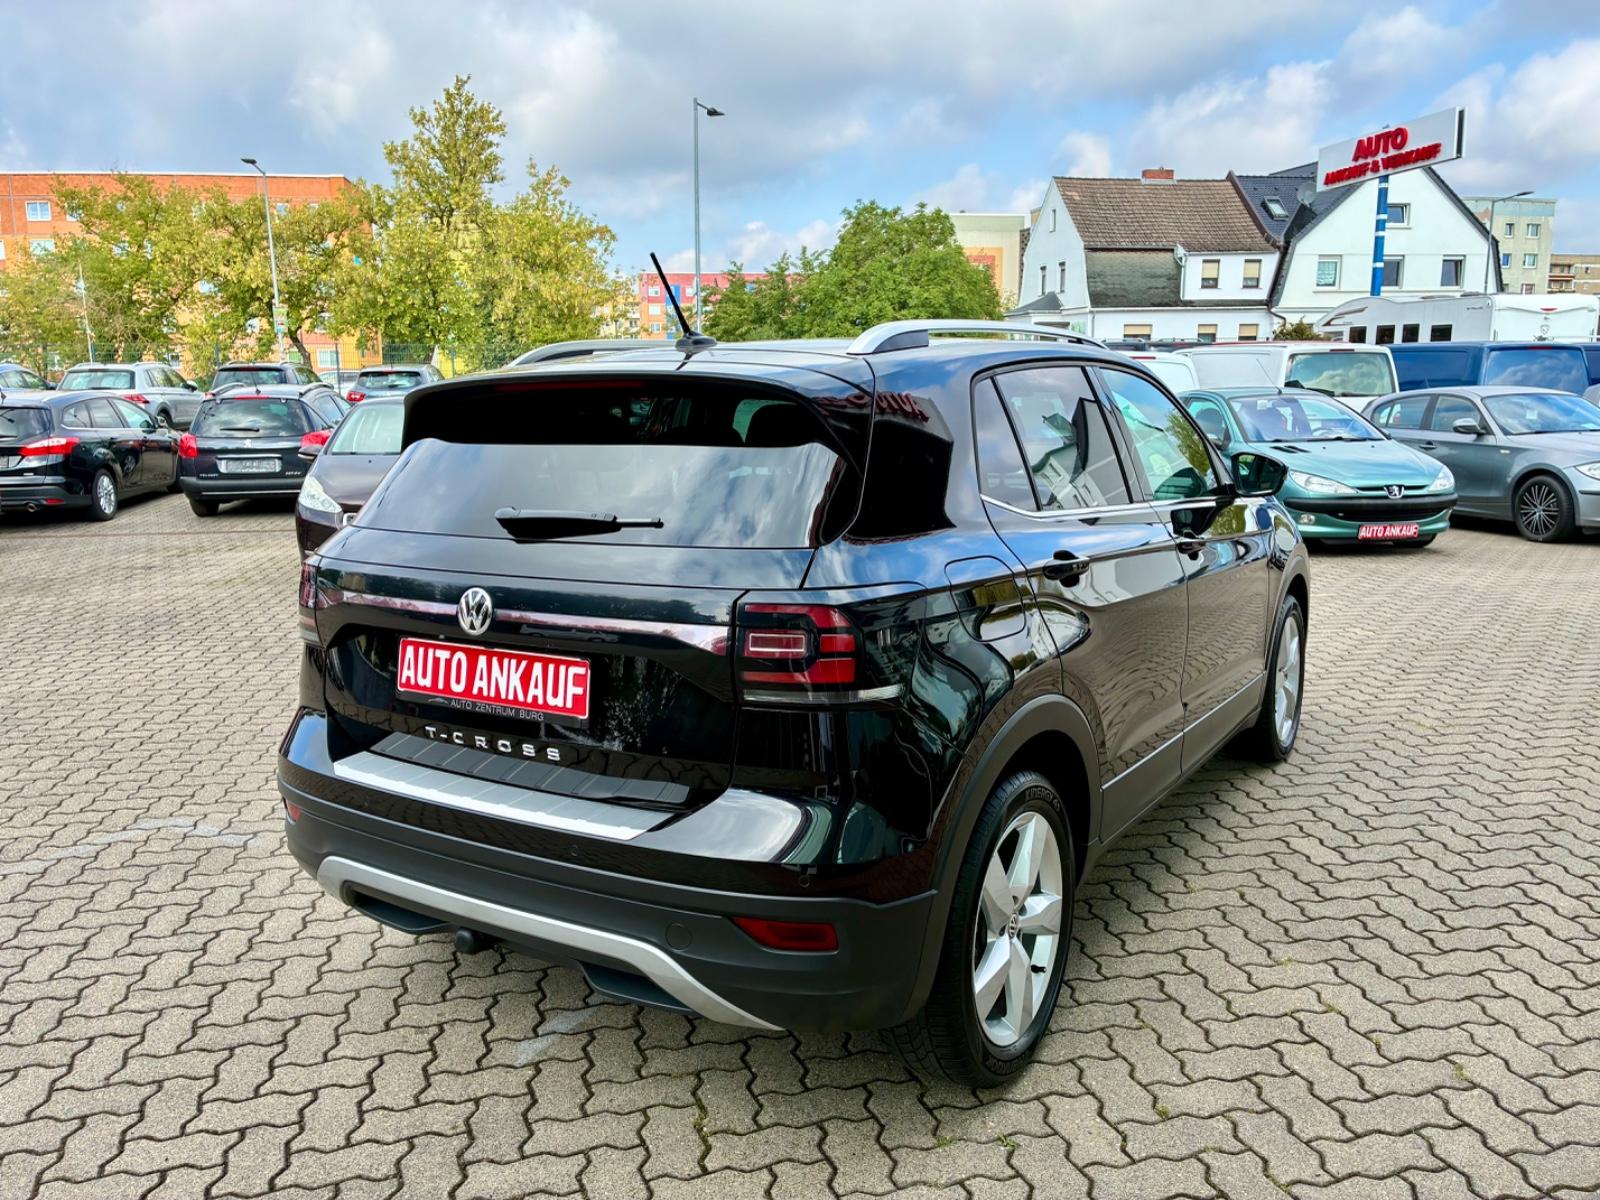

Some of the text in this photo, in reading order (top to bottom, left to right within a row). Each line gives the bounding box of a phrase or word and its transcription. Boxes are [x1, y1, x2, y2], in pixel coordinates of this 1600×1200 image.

[1353, 128, 1408, 161] AUTO
[1360, 523, 1418, 537] AUTO ANKAUF
[401, 645, 587, 708] AUTO ANKAUF
[450, 700, 544, 722] AUTO ZENTRUM BURG
[425, 726, 561, 762] T-CROSS
